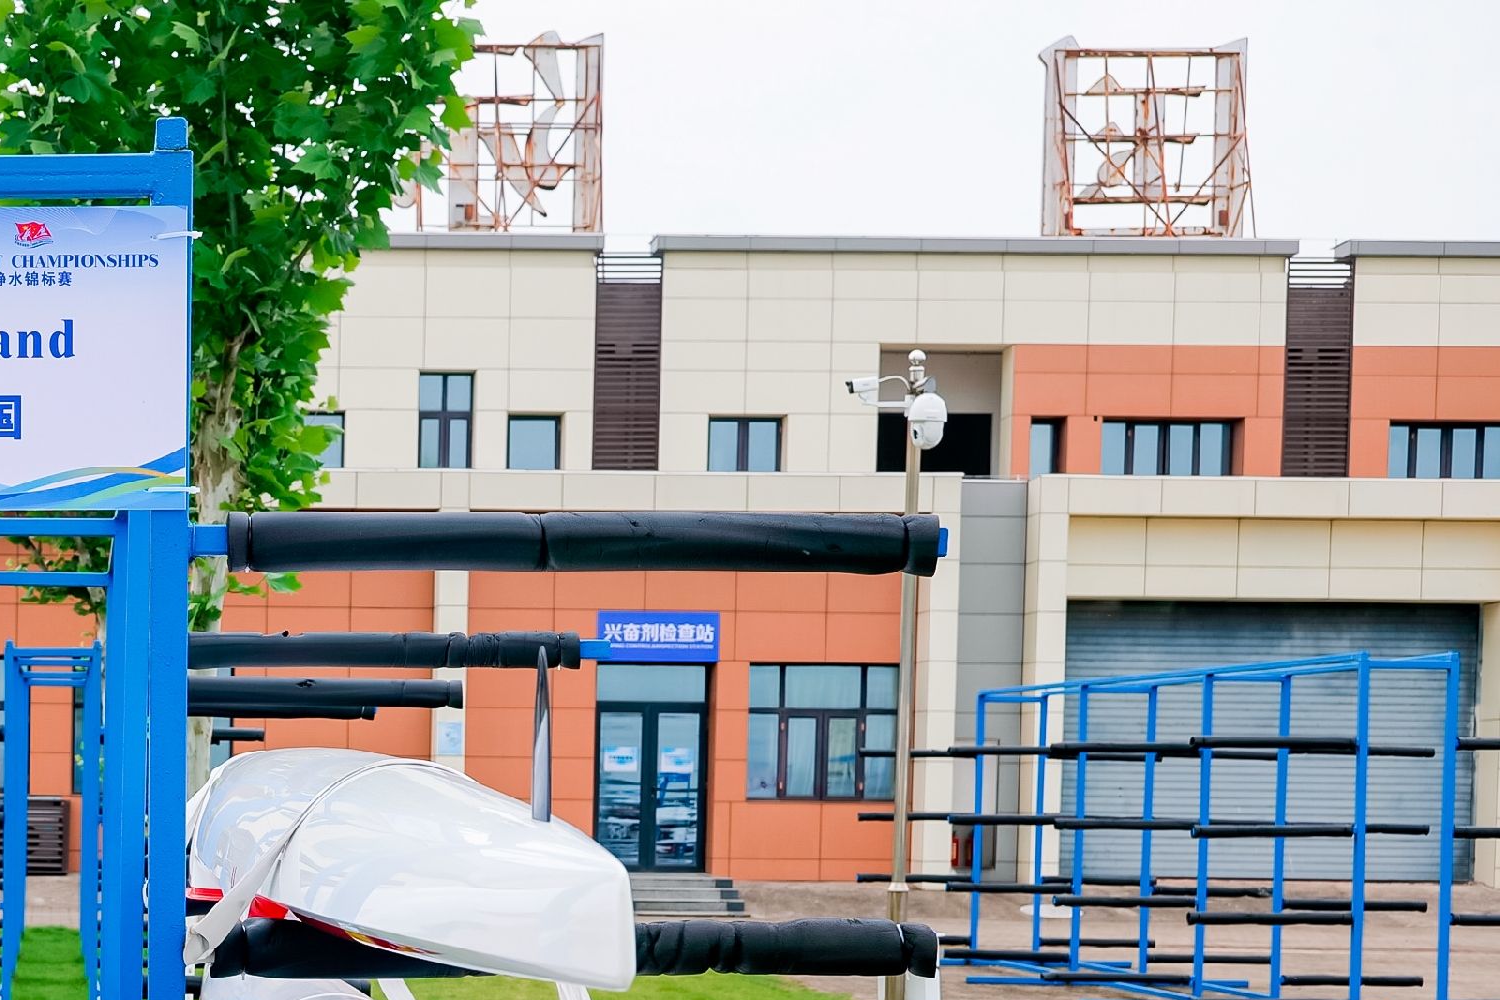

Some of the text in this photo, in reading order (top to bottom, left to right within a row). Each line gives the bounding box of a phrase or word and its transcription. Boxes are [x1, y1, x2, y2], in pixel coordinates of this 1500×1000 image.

[11, 254, 160, 269] CHAMPIONSHIPS
[603, 622, 715, 643] 兴奋剂检查站
